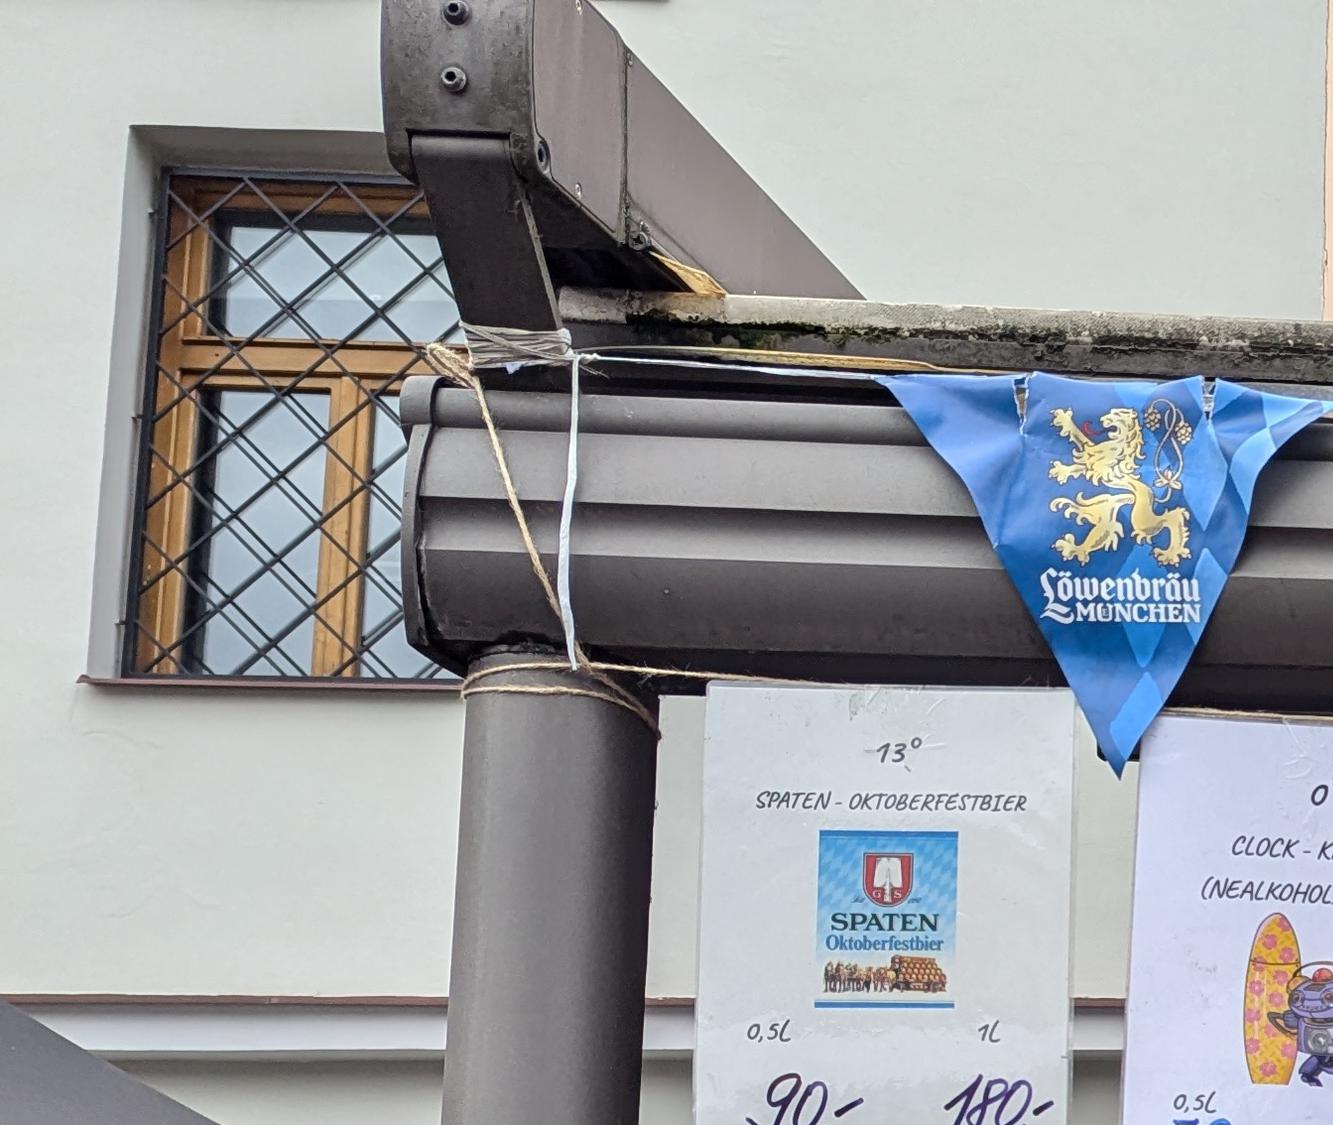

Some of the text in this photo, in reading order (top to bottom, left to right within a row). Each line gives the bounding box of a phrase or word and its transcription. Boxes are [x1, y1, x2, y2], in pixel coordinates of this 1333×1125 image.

[1040, 567, 1201, 624] Löwenbräu
[755, 790, 833, 812] SPATEN
[848, 792, 1028, 813] OKTOBERFESTBIER
[1231, 835, 1301, 860] CLOCK
[830, 912, 940, 933] SPATEN
[825, 934, 945, 952] Oktoberfestbier
